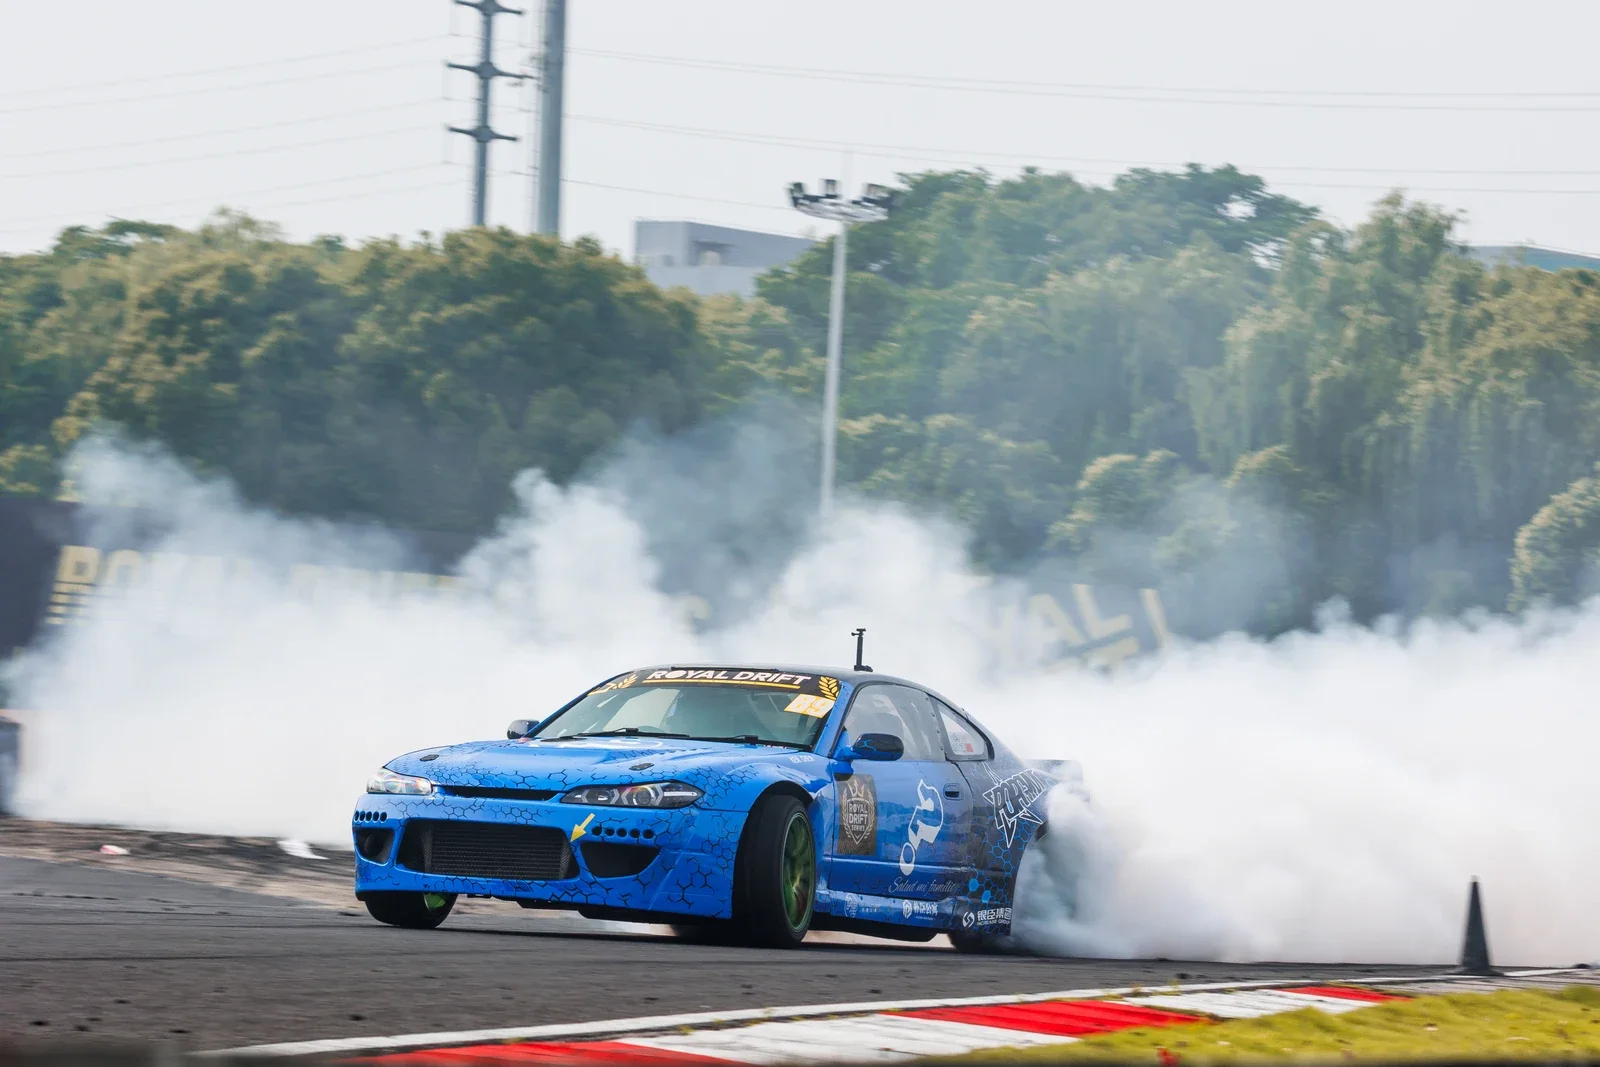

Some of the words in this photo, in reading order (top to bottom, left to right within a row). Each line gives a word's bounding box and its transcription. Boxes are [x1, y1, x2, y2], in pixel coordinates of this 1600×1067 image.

[646, 670, 730, 680] ROYAL
[732, 671, 812, 685] DRIFT
[785, 693, 835, 718] 89
[848, 803, 868, 814] ROYAL
[848, 813, 868, 825] DRIFT
[851, 824, 865, 832] SERIES
[888, 876, 918, 893] Salud
